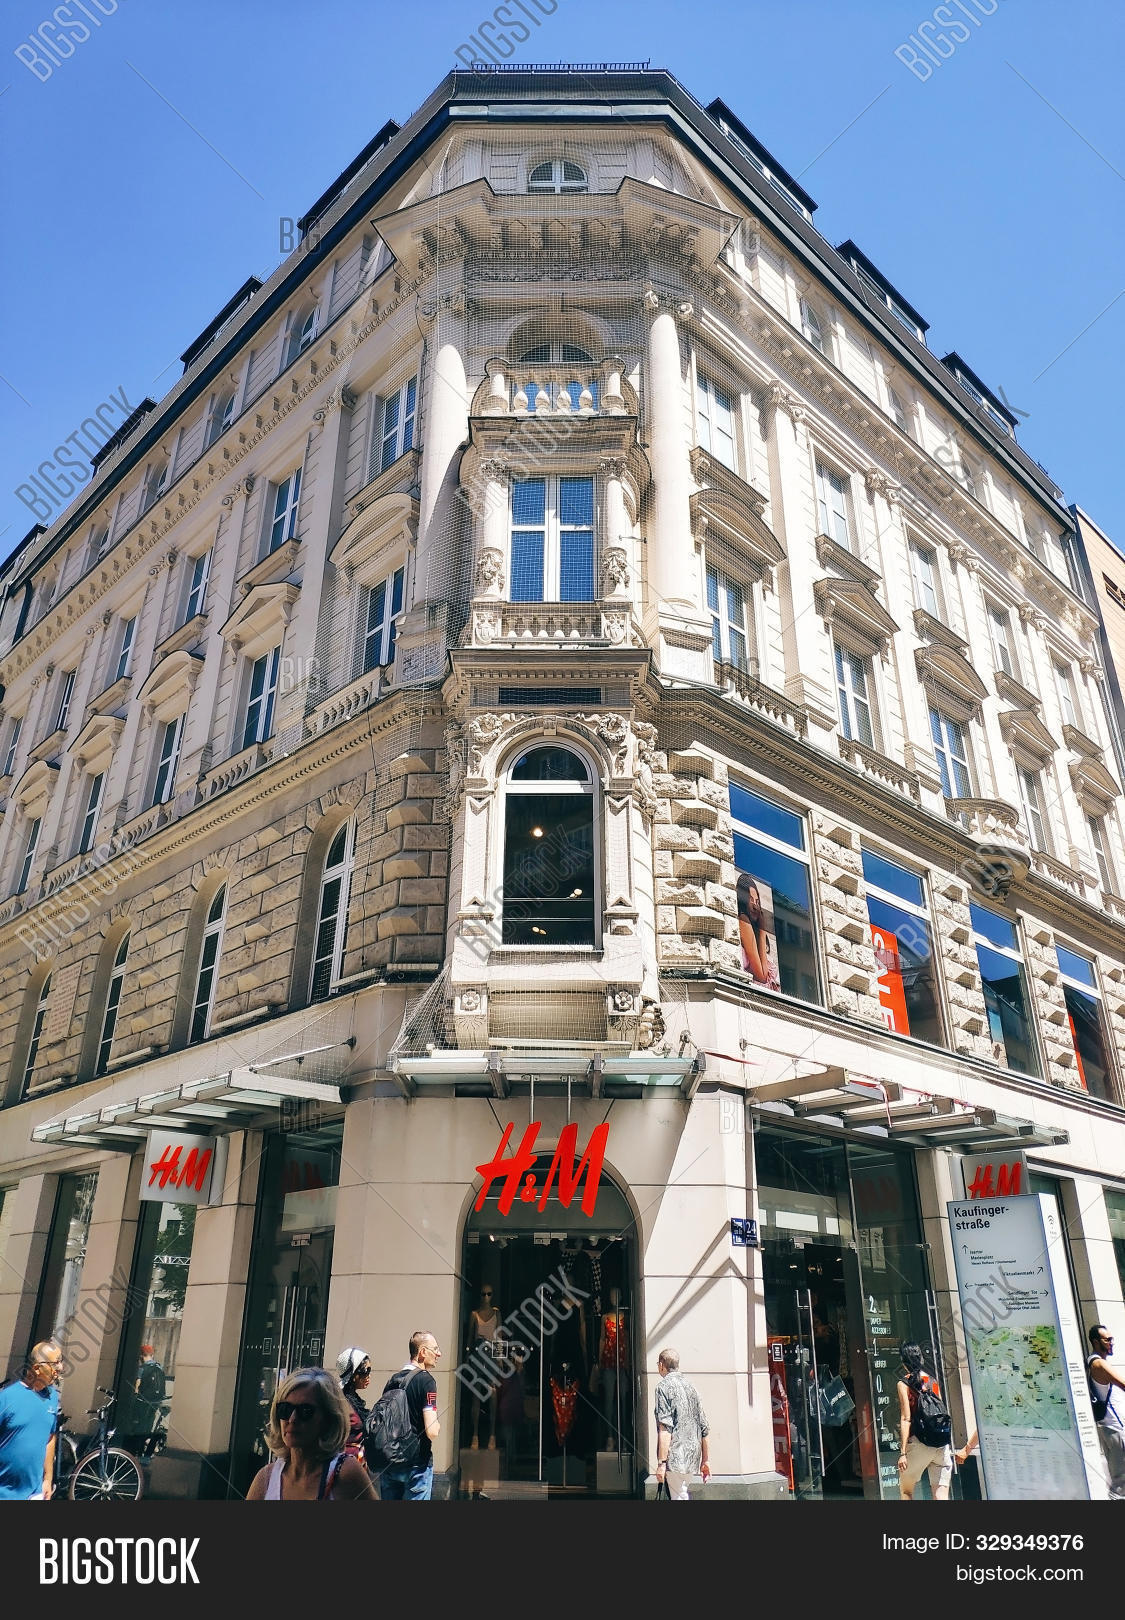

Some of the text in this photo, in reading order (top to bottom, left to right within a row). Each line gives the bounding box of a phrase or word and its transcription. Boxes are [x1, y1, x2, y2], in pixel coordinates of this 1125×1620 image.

[148, 1145, 212, 1192] H&M
[474, 1121, 609, 1217] H&M
[954, 1205, 1010, 1218] Kaufinger-
[746, 1221, 757, 1235] 24
[956, 1219, 991, 1231] straße
